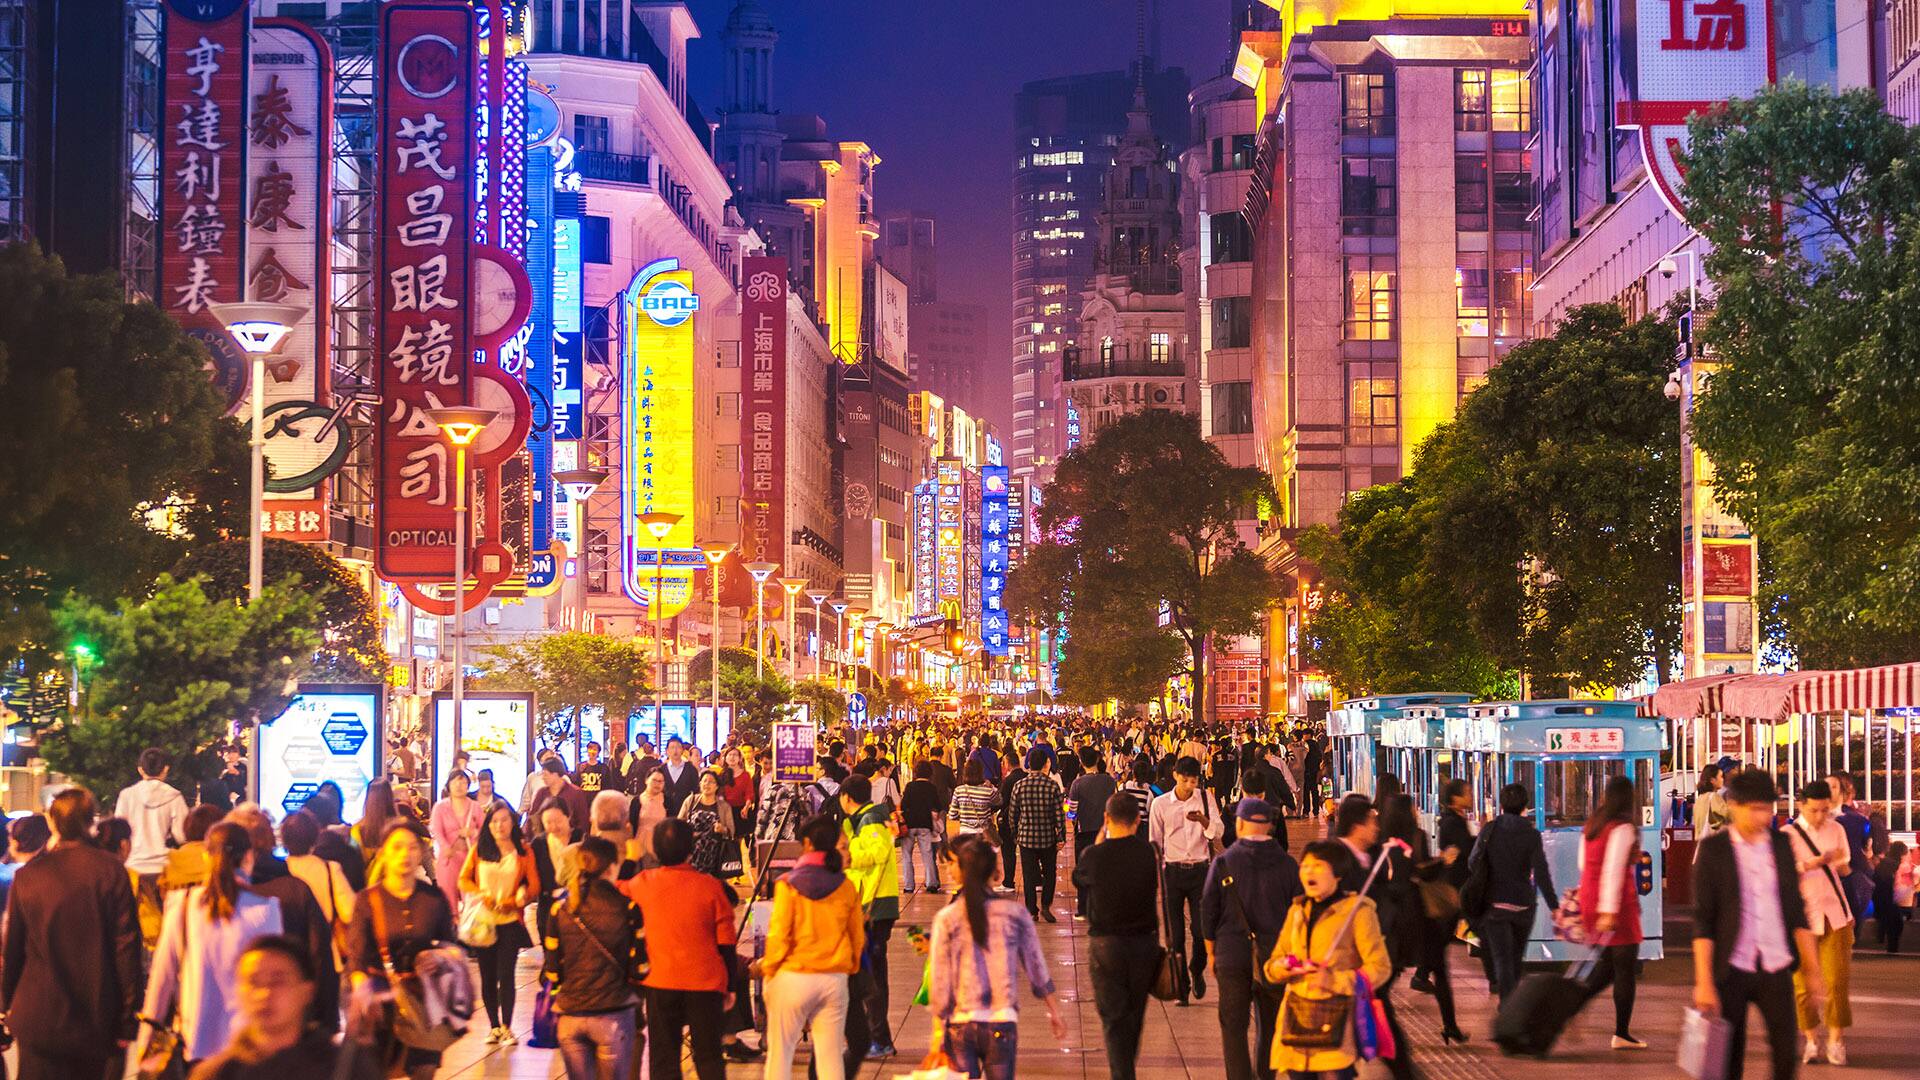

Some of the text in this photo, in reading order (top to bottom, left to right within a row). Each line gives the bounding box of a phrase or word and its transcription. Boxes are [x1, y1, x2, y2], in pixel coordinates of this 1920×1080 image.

[173, 36, 231, 315] 亨達利鐘表
[388, 112, 460, 506] 茂昌眼镜公司
[642, 297, 698, 310] BAC
[753, 312, 774, 491] 上海市第一食品商店
[388, 530, 457, 547] OPTICAL
[778, 726, 815, 749] 快照
[1570, 731, 1618, 744] 观光车
[1645, 808, 1652, 825] 2
